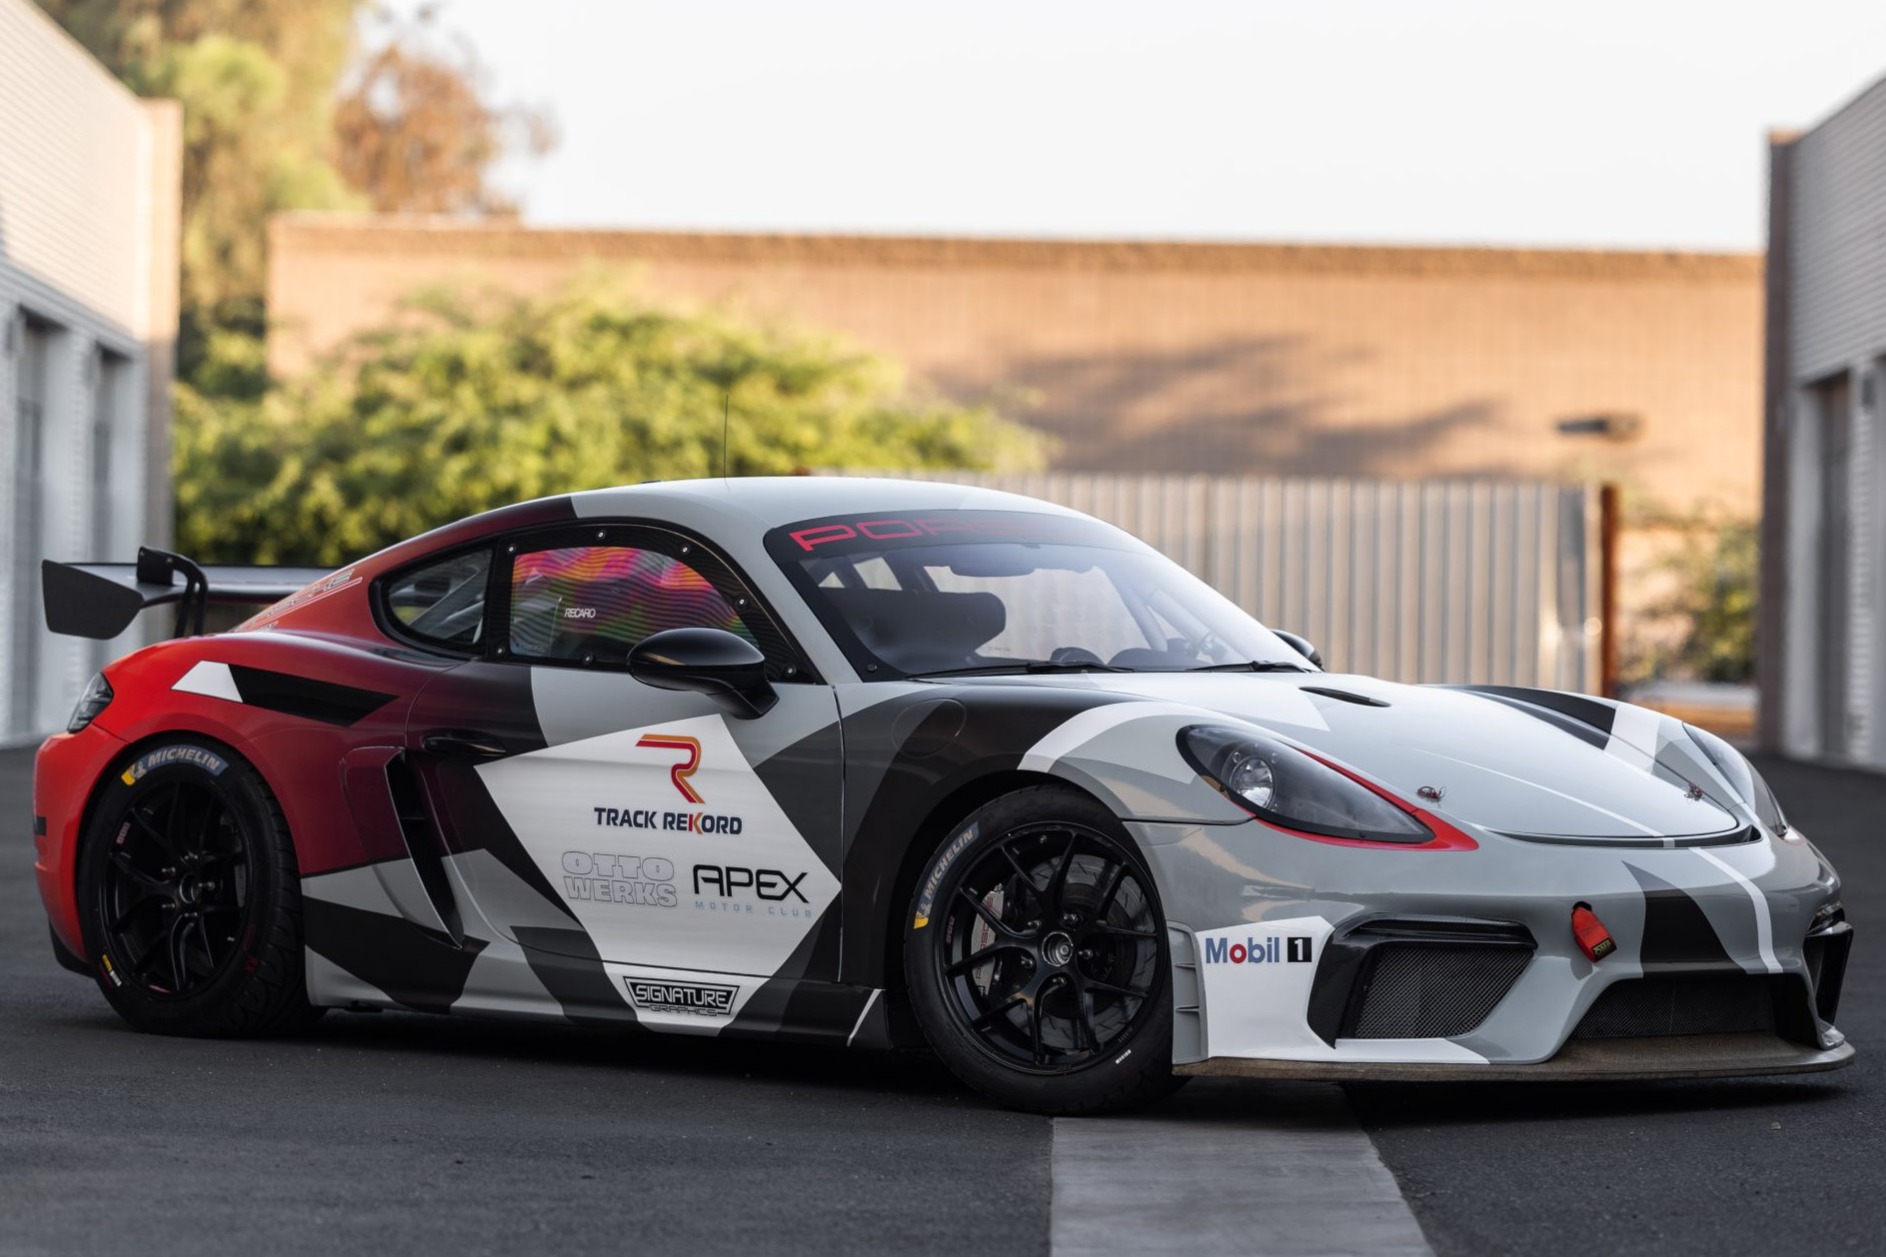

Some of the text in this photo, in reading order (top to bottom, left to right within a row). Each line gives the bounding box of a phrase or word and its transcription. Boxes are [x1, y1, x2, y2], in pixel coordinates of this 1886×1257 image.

[564, 607, 597, 619] RECARO
[147, 747, 221, 771] MICHELIN
[594, 807, 743, 836] TRACK REKORD
[561, 850, 675, 882] OTTO
[924, 828, 975, 900] MICHELIN
[563, 876, 678, 908] WERKS
[692, 864, 810, 904] APEX
[695, 901, 813, 919] MOTOR CLUB
[1205, 936, 1280, 965] Mobil
[635, 984, 730, 1009] SIGNATURE
